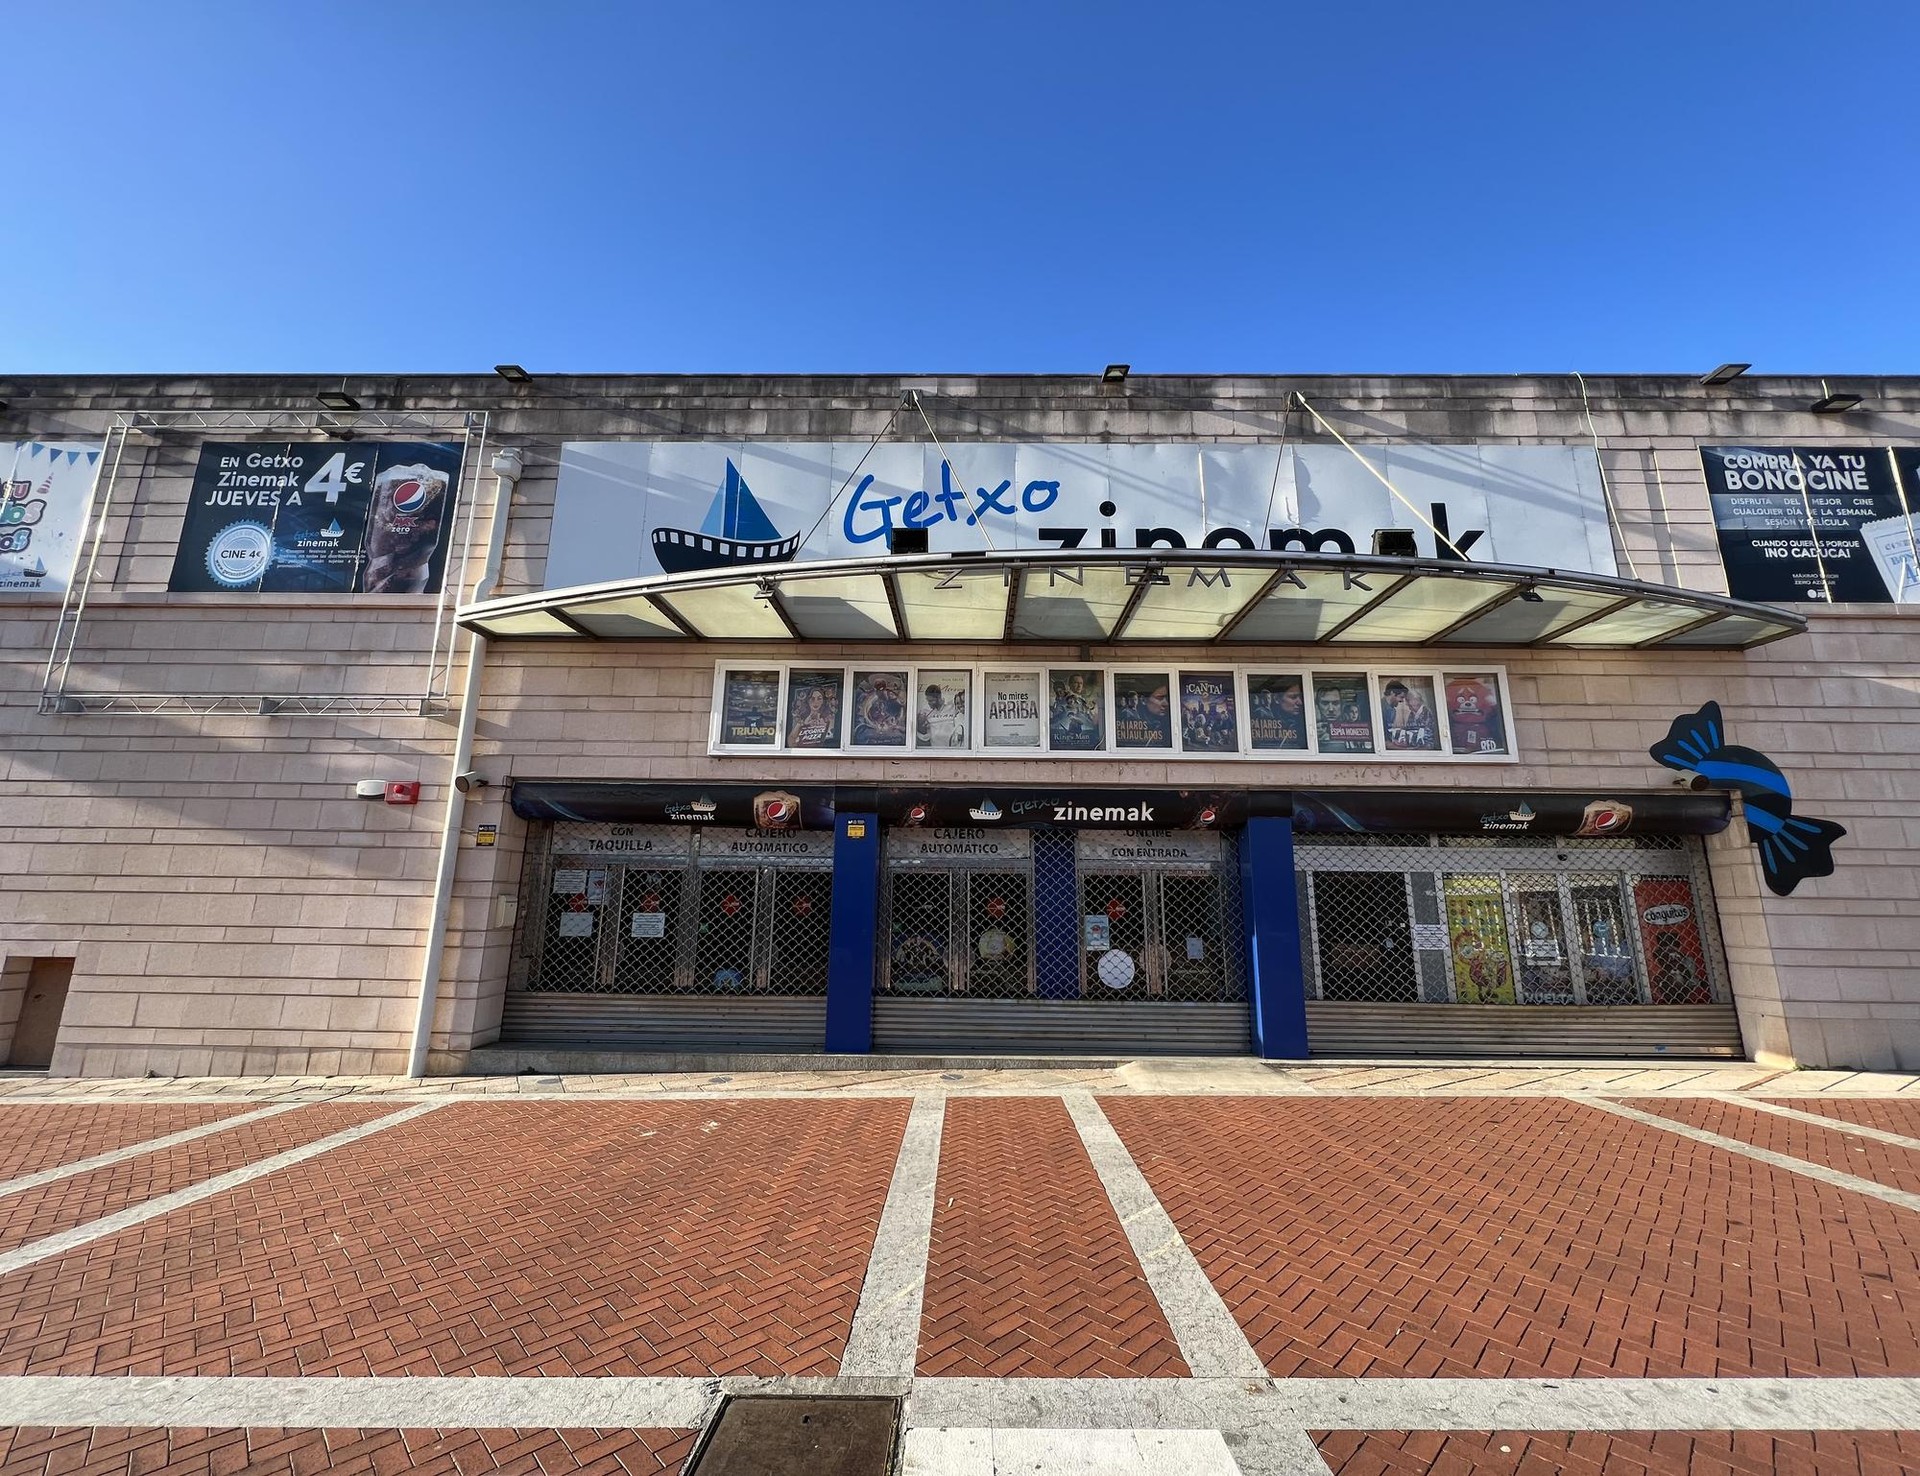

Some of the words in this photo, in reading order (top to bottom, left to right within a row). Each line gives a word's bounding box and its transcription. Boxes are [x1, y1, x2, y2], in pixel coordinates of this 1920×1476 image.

[220, 457, 240, 468] EN
[246, 453, 304, 468] Getxo
[1809, 455, 1836, 469] YA
[1839, 455, 1866, 469] TU
[217, 471, 299, 487] Zinemak
[205, 491, 281, 506] JUEVES
[285, 491, 302, 506] A
[1731, 498, 1773, 506] DISFRUTA
[1812, 498, 1842, 506] MEJOR
[1852, 498, 1874, 506] CINE
[843, 460, 1060, 552] Getxo
[1733, 508, 1783, 516] CUALQUIER
[1787, 507, 1803, 516] DÍA
[1821, 508, 1833, 516] LA
[1799, 518, 1805, 526] Y
[297, 538, 339, 548] zinemak
[1752, 540, 1788, 548] CUANDO
[1790, 540, 1824, 548] QUIERS
[221, 550, 246, 559] CINE
[997, 691, 1007, 701] No
[1008, 691, 1029, 701] mires
[989, 700, 1039, 719] ARRIBA
[731, 727, 776, 737] TRIUNFO
[670, 811, 715, 821] zinemak
[1053, 801, 1154, 821] zinemak
[1482, 820, 1530, 830] zinemak
[611, 827, 634, 836] CON
[933, 828, 986, 839] CAJERO
[589, 839, 653, 851] TAQUILLA
[731, 840, 809, 852] AUTOMÁTICO
[920, 841, 999, 854] AUTOMÁTICO
[1112, 848, 1134, 857] CON
[1136, 848, 1188, 858] ENTRADA
